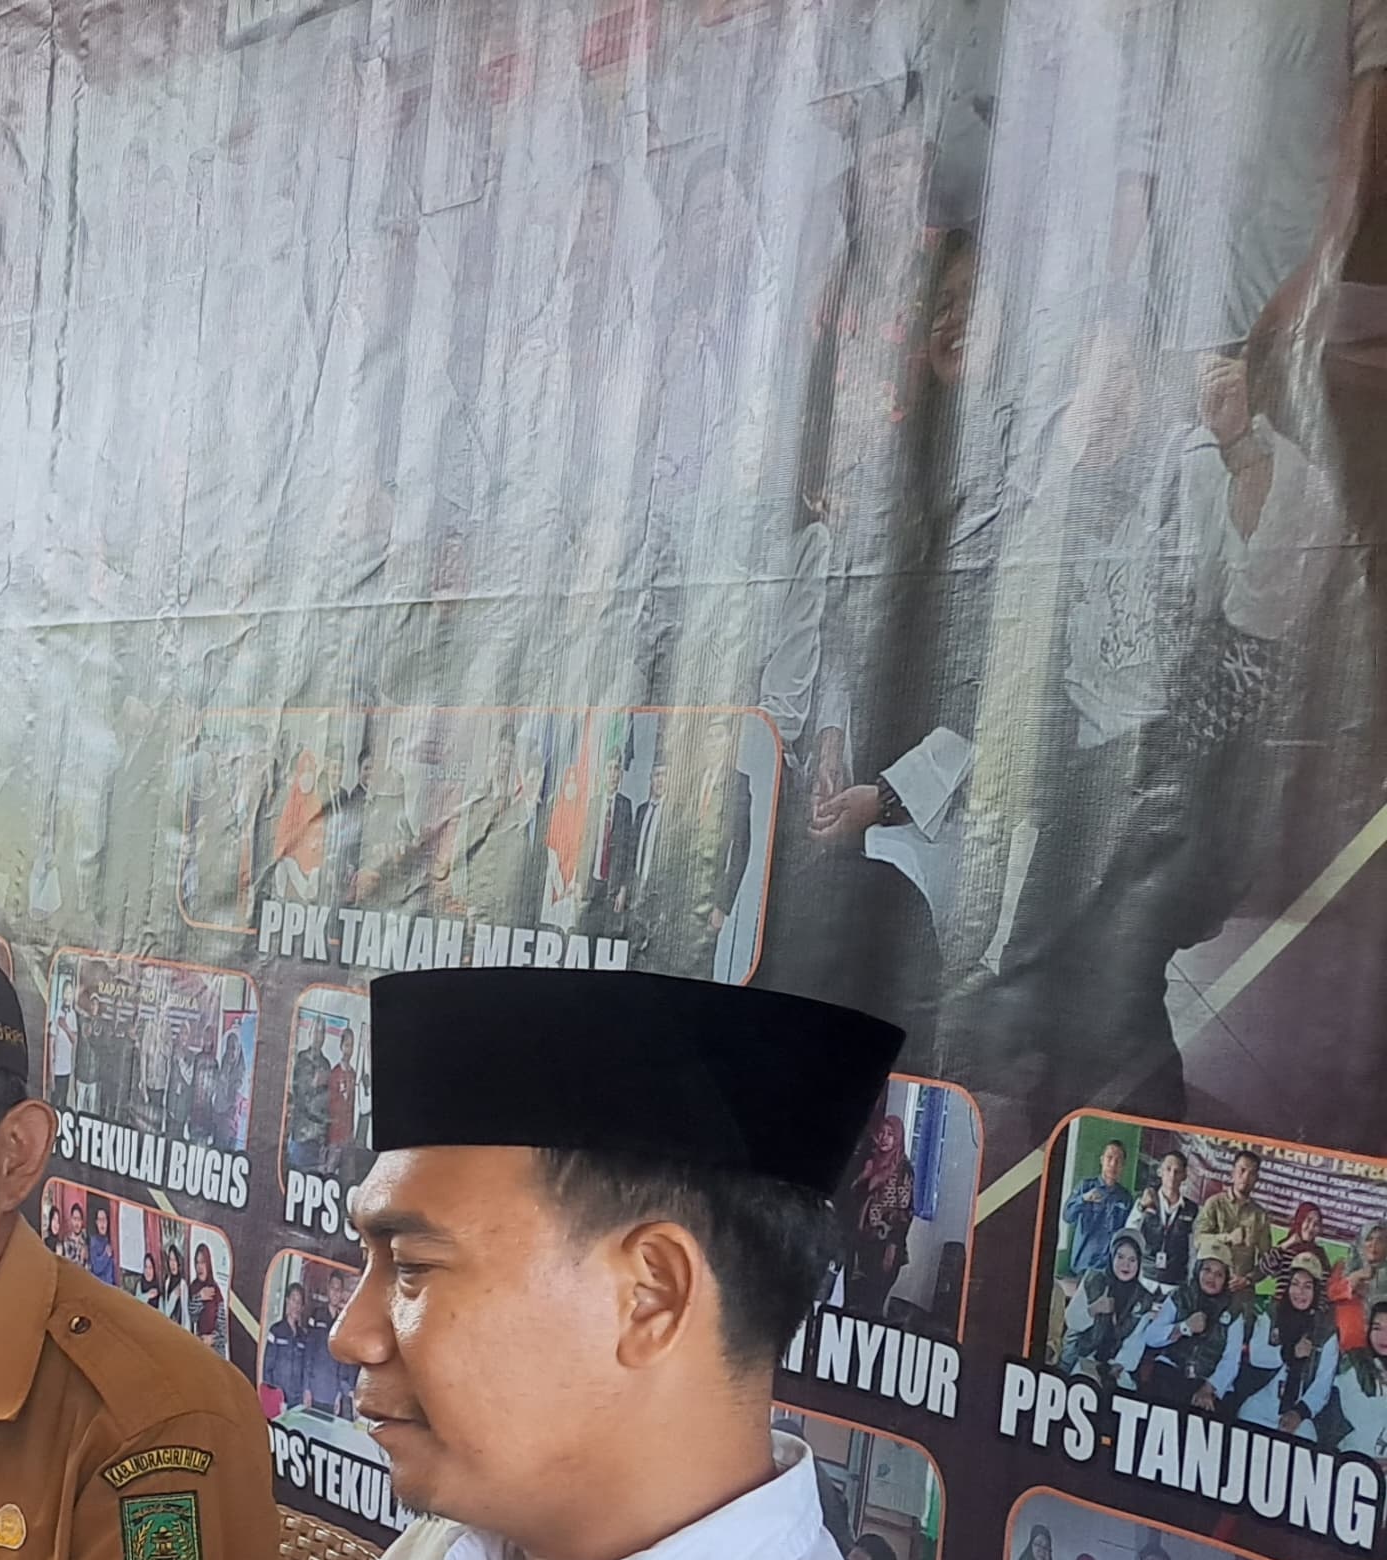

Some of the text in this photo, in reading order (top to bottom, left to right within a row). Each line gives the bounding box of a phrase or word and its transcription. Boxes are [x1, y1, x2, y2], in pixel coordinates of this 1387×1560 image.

[259, 900, 329, 962] PPK
[338, 908, 465, 972] TANAH
[79, 1117, 166, 1186] TEKULAI
[167, 1140, 249, 1208] BUGIS
[285, 1169, 340, 1234] PPS
[816, 1312, 960, 1419] NYIUR
[267, 1423, 307, 1488] PS
[999, 1363, 1098, 1462] PPS
[1112, 1395, 1379, 1550] TANJUNG
